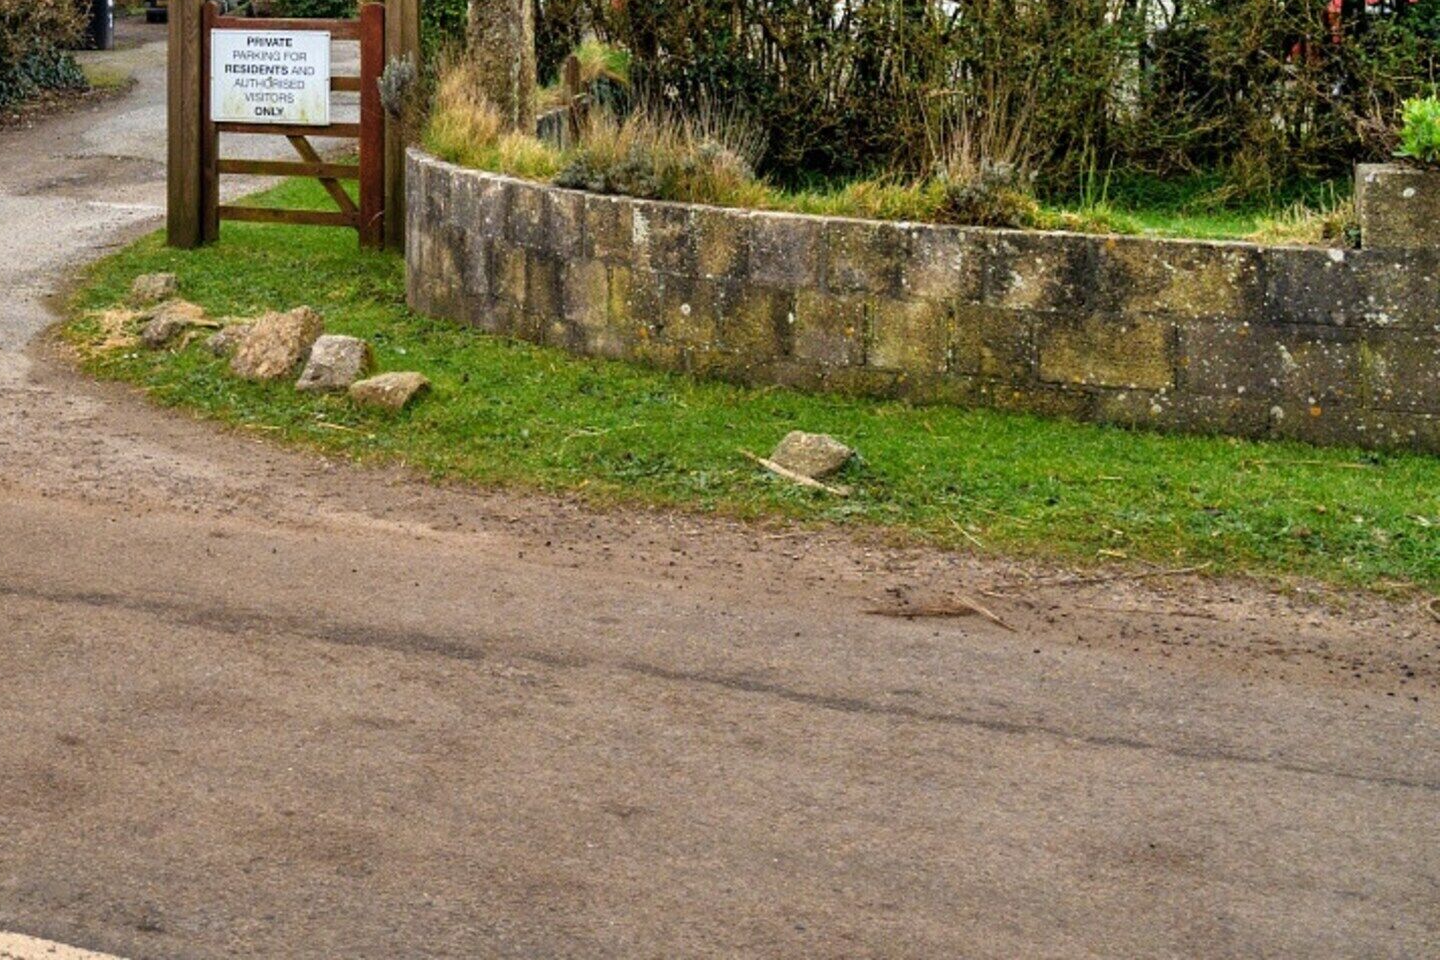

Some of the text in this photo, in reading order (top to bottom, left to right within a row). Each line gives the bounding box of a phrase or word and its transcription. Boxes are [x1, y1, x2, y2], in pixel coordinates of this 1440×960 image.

[247, 36, 293, 47] PRIVATE
[232, 50, 307, 62] PARKING FOR
[224, 64, 315, 76] RESIDENTS AND
[234, 78, 305, 89] AUTHORISED
[245, 92, 295, 104] VISITORS
[255, 106, 284, 116] ONLY
